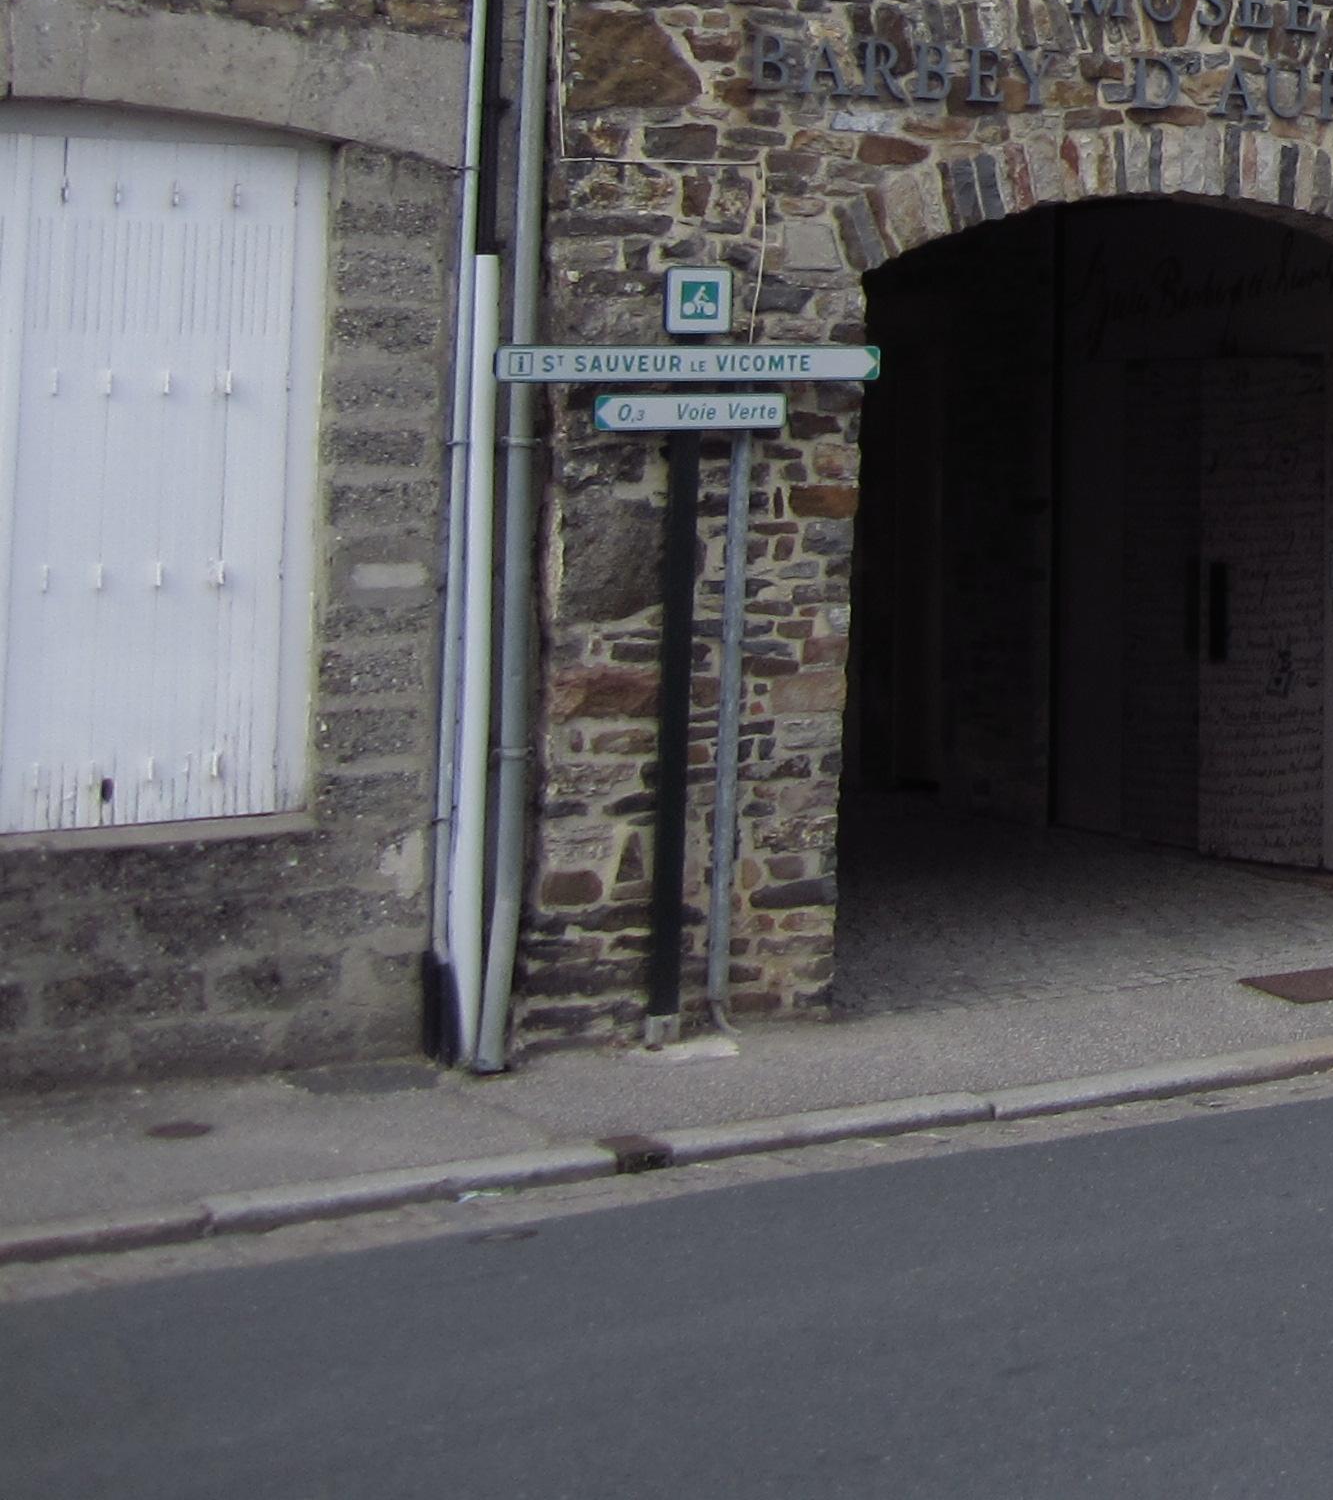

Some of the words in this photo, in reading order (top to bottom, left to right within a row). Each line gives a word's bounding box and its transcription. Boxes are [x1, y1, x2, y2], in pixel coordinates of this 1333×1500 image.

[746, 32, 1053, 106] BARBEY
[574, 355, 681, 373] SAUVEUR
[690, 361, 706, 373] LE
[716, 354, 811, 372] VICOMTE
[677, 403, 716, 421] Voie
[728, 403, 777, 420] Verte
